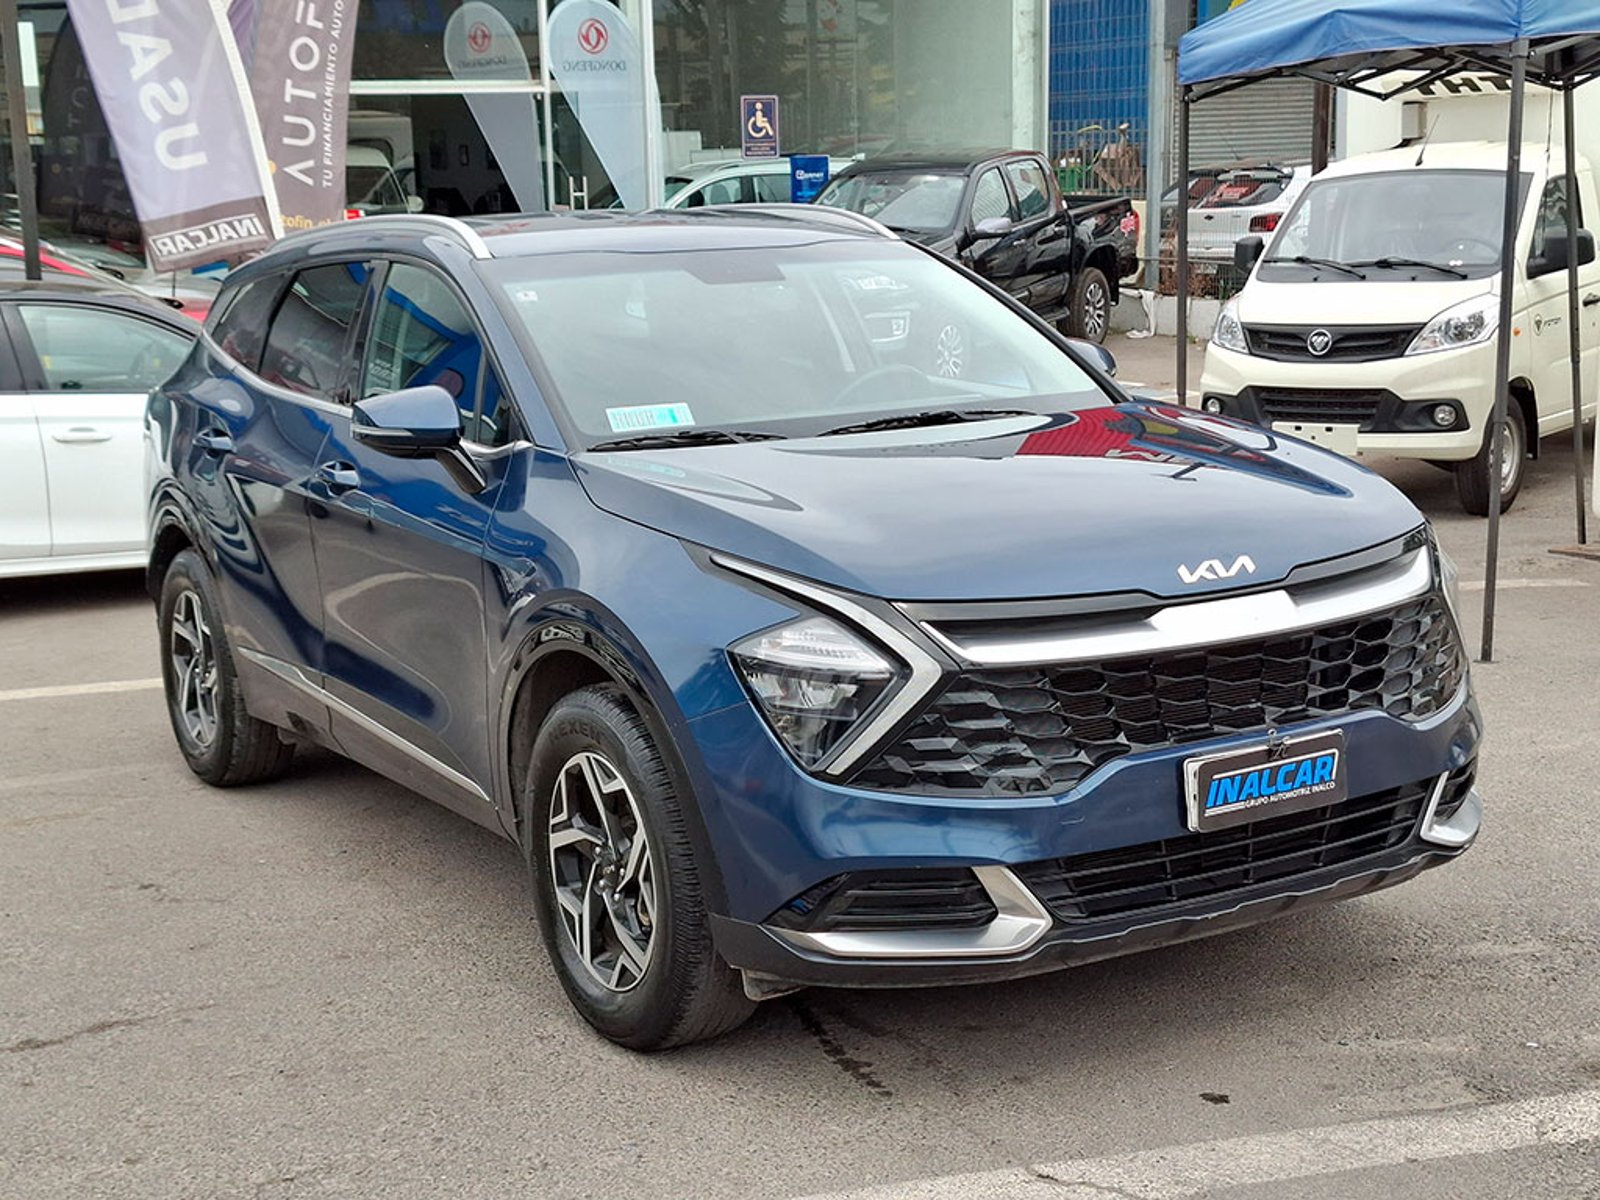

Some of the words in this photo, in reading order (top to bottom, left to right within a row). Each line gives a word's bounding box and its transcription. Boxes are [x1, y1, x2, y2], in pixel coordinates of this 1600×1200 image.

[322, 43, 339, 166] FINANCIAMIENTO
[321, 170, 333, 188] TU
[1177, 554, 1256, 583] KIA
[1206, 755, 1334, 808] INALCAR
[1245, 796, 1269, 808] GRUPO
[1269, 787, 1311, 804] AUTOMOTRIZ
[1311, 781, 1336, 795] INALCO
